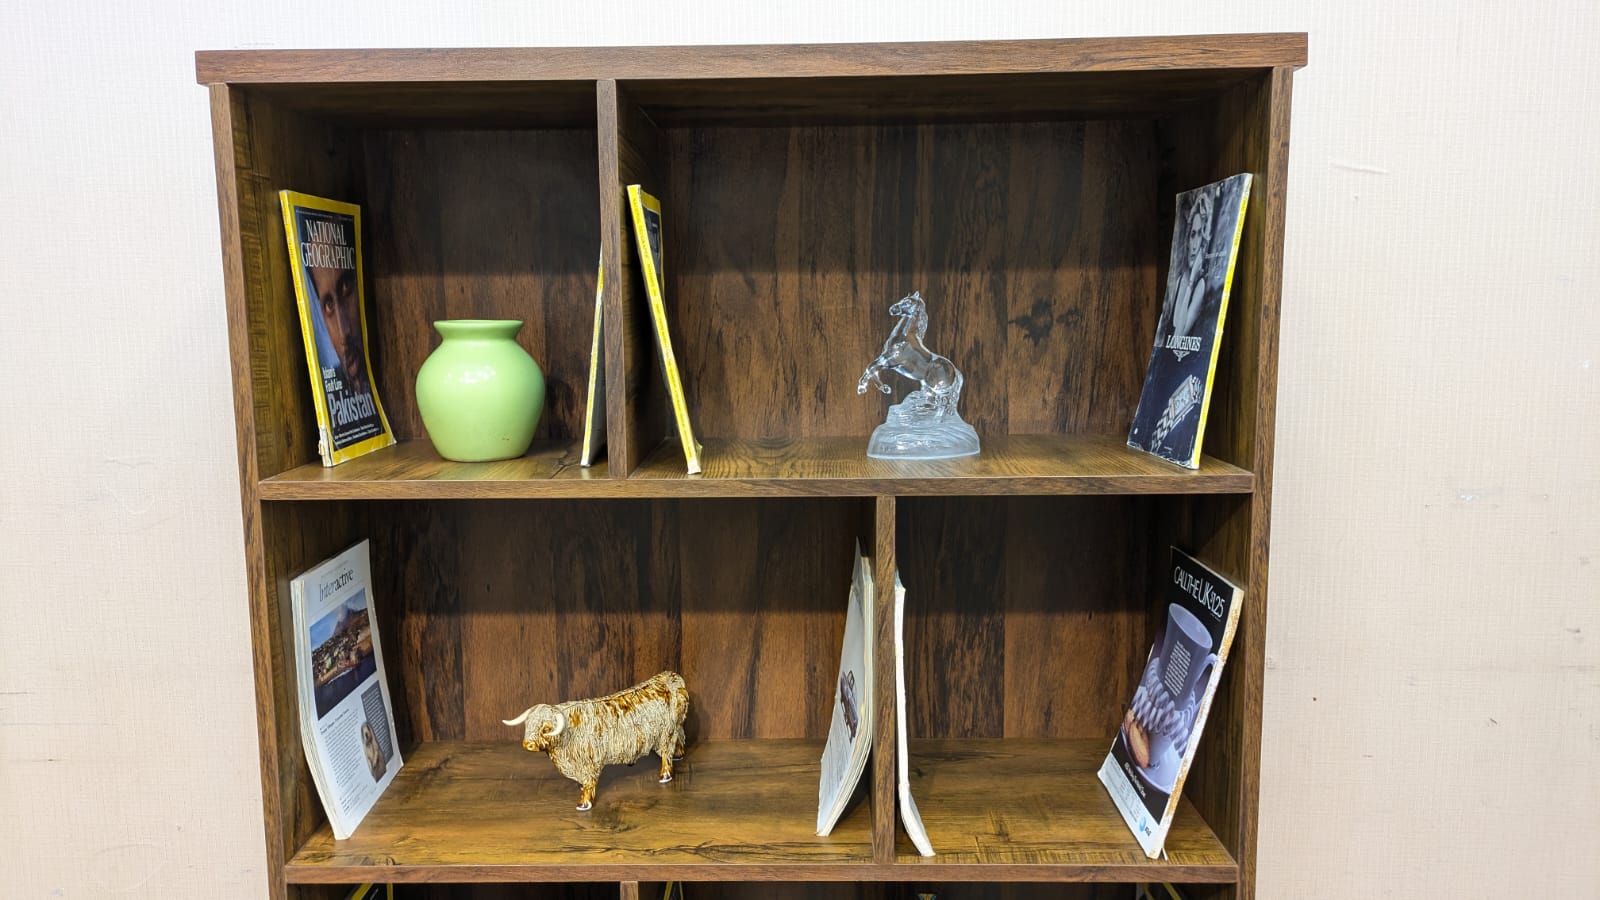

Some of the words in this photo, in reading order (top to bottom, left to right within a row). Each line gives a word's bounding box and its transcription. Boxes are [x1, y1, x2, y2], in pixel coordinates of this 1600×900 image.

[305, 219, 347, 246] NATIONAL
[300, 241, 355, 270] GEOGRAPHIC
[1165, 335, 1202, 352] LONGINES
[328, 389, 376, 428] Pakistan
[319, 567, 354, 602] Interactive
[1174, 566, 1187, 592] CALL
[1186, 574, 1200, 599] THE
[1198, 578, 1214, 610] UK
